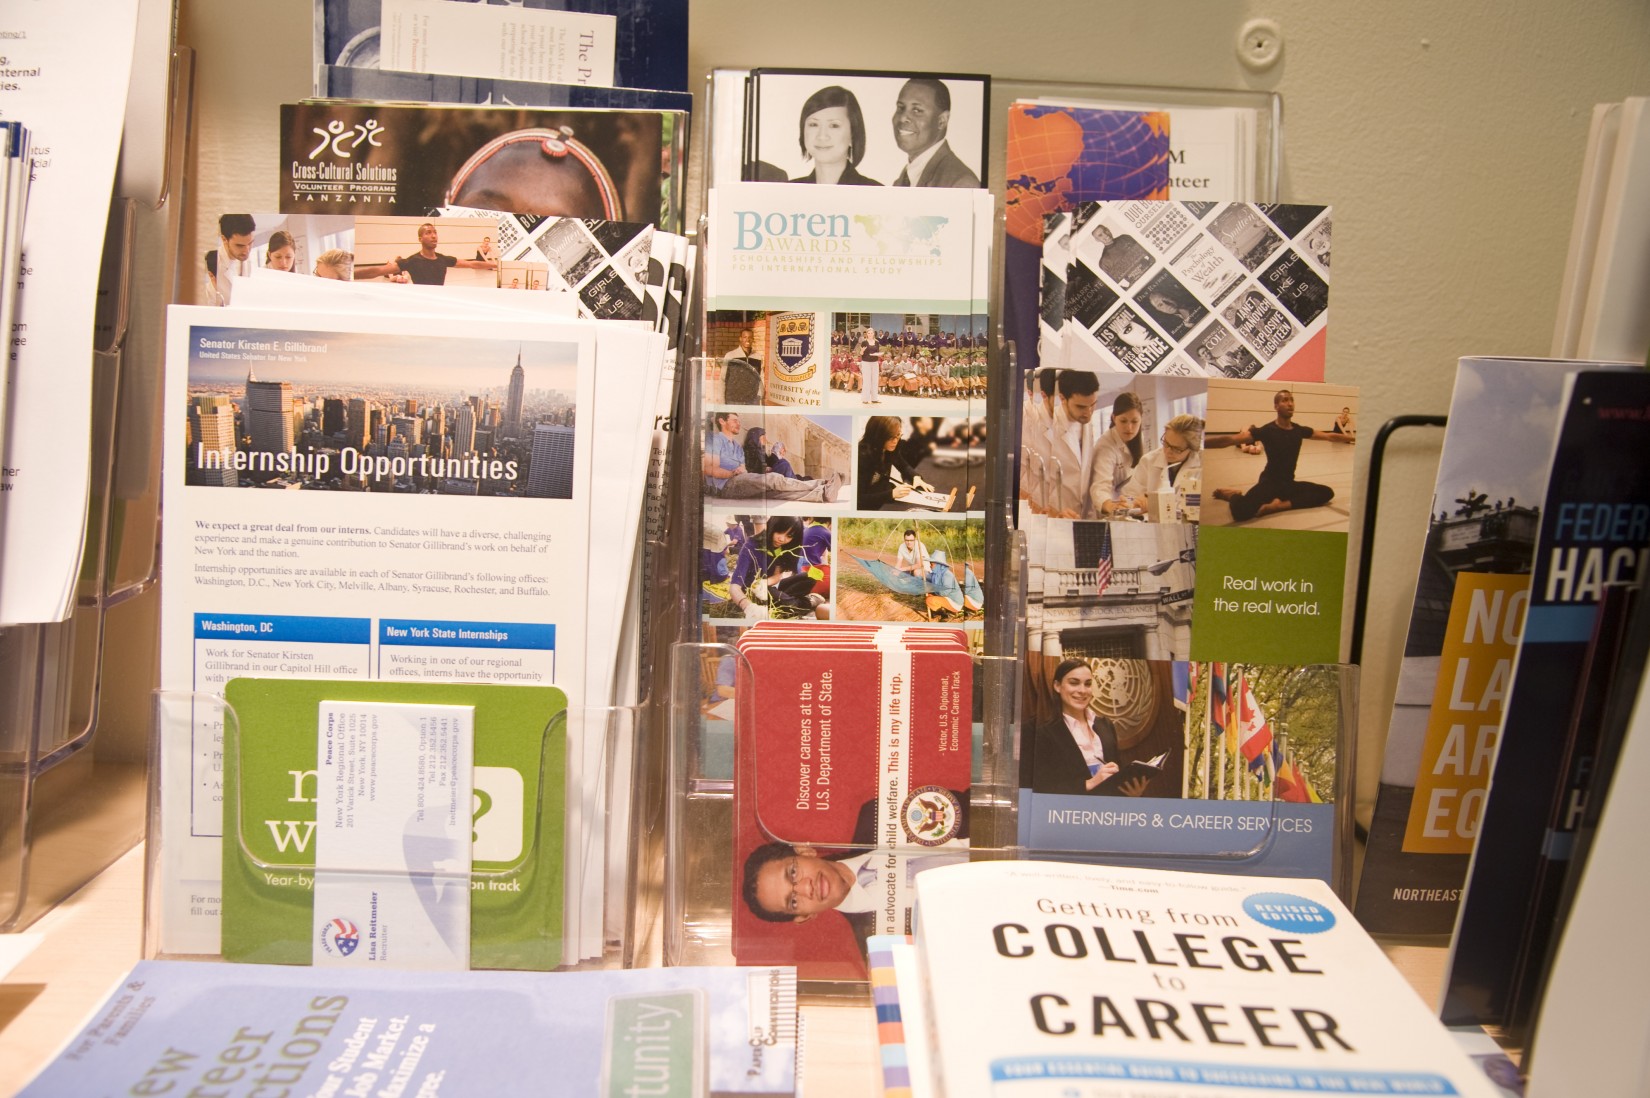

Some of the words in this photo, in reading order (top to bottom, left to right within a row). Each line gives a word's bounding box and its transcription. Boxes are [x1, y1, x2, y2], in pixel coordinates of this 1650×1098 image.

[578, 31, 595, 61] The
[292, 160, 354, 181] Cross-Cultural
[356, 162, 398, 182] Solutions
[293, 193, 397, 203] TANZANIA
[294, 183, 344, 191] VOLUNTEER
[349, 184, 396, 193] PROGRAMS
[733, 210, 851, 251] Boren
[763, 237, 851, 253] AWARDS
[732, 254, 823, 264] SCHOLARSHIPS
[830, 256, 854, 265] AND
[860, 257, 943, 267] FELLOWSHIPS
[732, 263, 754, 272] FOR
[761, 264, 858, 275] INTERNATIONAL
[864, 267, 903, 275] STUDY
[1181, 246, 1215, 277] Psychology
[1191, 256, 1224, 282] Wealth
[1269, 252, 1300, 282] GIRLS
[1292, 282, 1309, 299] US
[1236, 296, 1256, 321] JANET
[1239, 297, 1271, 337] EVANOVICH
[1096, 328, 1115, 346] LIS
[1205, 327, 1228, 350] COLT
[1252, 310, 1284, 350] EXPLOSIVE
[1262, 321, 1292, 356] EIGHTEEN
[200, 337, 235, 350] Senator
[238, 339, 271, 351] Kirsten
[273, 341, 282, 351] E.
[284, 341, 328, 354] Gillibrand
[1129, 336, 1169, 374] JUSTICE
[197, 442, 330, 480] Internship
[340, 446, 518, 481] Opportunities
[195, 520, 210, 530] We
[212, 522, 240, 532] expect
[250, 523, 273, 533] great
[275, 523, 294, 532] deal
[296, 524, 318, 533] from
[320, 526, 336, 534] our
[338, 525, 372, 535] interns.
[373, 526, 420, 536] Candidates
[422, 528, 438, 537] will
[440, 529, 460, 538] have
[469, 530, 501, 540] diverse,
[503, 531, 552, 543] challenging
[1223, 575, 1258, 591] Real
[1261, 578, 1297, 593] work
[1300, 579, 1314, 593] in
[1213, 597, 1239, 612] the
[1242, 600, 1272, 613] real
[1275, 601, 1321, 616] world.
[201, 620, 258, 634] Washington,
[260, 622, 274, 633] DC
[386, 626, 407, 638] New
[410, 627, 430, 638] York
[432, 628, 456, 639] State
[459, 629, 509, 642] Internships
[205, 648, 229, 658] Work
[231, 649, 245, 658] for
[247, 649, 280, 660] Senator
[282, 650, 314, 660] Kirsten
[390, 654, 427, 666] Working
[430, 656, 438, 665] in
[459, 656, 469, 665] of
[486, 658, 523, 668] regional
[819, 668, 833, 702] State.
[891, 672, 903, 697] trip.
[951, 670, 961, 690] Track
[799, 682, 813, 702] the
[940, 676, 950, 711] Diplomat,
[951, 690, 960, 716] Career
[800, 703, 812, 716] at
[818, 703, 832, 717] of
[889, 698, 902, 716] life
[939, 707, 948, 727] U.S.
[326, 712, 334, 738] Corps
[337, 713, 346, 742] Office
[891, 718, 904, 735] my
[950, 718, 959, 751] Economic
[348, 734, 356, 756] Suite
[359, 739, 367, 752] NY
[800, 718, 812, 760] careers
[889, 737, 900, 751] is
[938, 728, 949, 752] Victor,
[325, 739, 333, 766] Peace
[336, 743, 346, 782] Regional
[817, 719, 832, 785] Department
[887, 752, 900, 774] This
[336, 784, 344, 804] York
[796, 763, 810, 810] Discover
[887, 776, 899, 814] welfare.
[346, 789, 355, 813] Varick
[816, 789, 830, 811] U.S.
[335, 808, 343, 829] New
[1048, 809, 1148, 827] INTERNSHIPS
[1151, 813, 1164, 828] &
[1169, 813, 1233, 830] CAREER
[1237, 816, 1313, 833] SERVICES
[885, 823, 897, 850] child
[885, 853, 897, 871] for
[488, 879, 521, 892] track
[885, 872, 897, 922] advocate
[369, 891, 378, 939] Reitmeier
[1036, 897, 1155, 925] Getting
[1166, 906, 1240, 928] from
[1255, 903, 1320, 915] REVISED
[1261, 911, 1325, 923] EDITION
[368, 941, 376, 961] Lisa
[379, 924, 388, 961] Recruiter
[991, 922, 1325, 976] COLLEGE
[126, 980, 146, 991] &
[1153, 971, 1187, 993] to
[418, 1022, 437, 1034] a
[1029, 992, 1357, 1054] CAREER
[328, 1016, 379, 1074] Student
[360, 1014, 411, 1071] Market.
